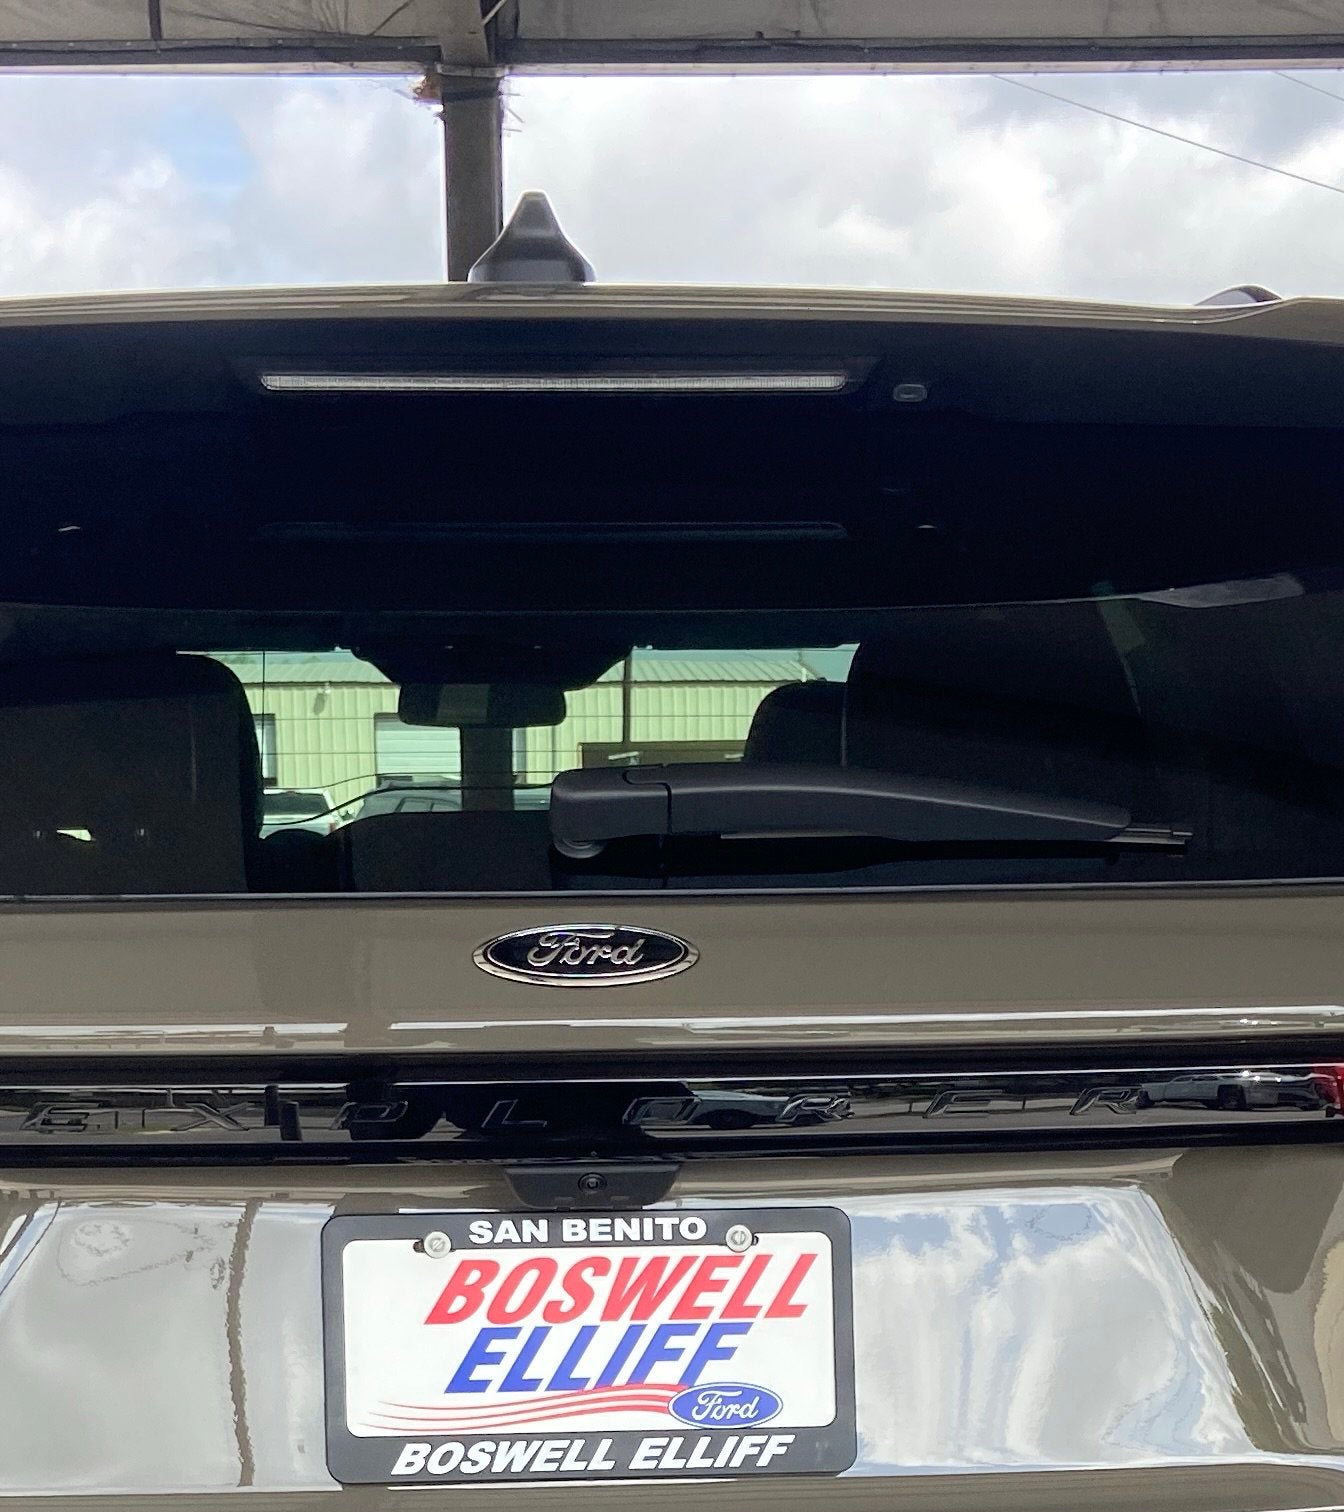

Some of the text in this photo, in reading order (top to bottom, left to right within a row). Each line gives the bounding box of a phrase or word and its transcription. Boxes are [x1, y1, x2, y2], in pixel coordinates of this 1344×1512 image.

[527, 931, 645, 967] Ford
[20, 1084, 1140, 1133] EXPLORER
[468, 1216, 708, 1244] SAN BENITO
[424, 1253, 818, 1325] BOSWELL
[444, 1321, 756, 1394] ELLIFF
[690, 1389, 760, 1421] Ford
[390, 1434, 796, 1476] BOSWELL ELLIFF
